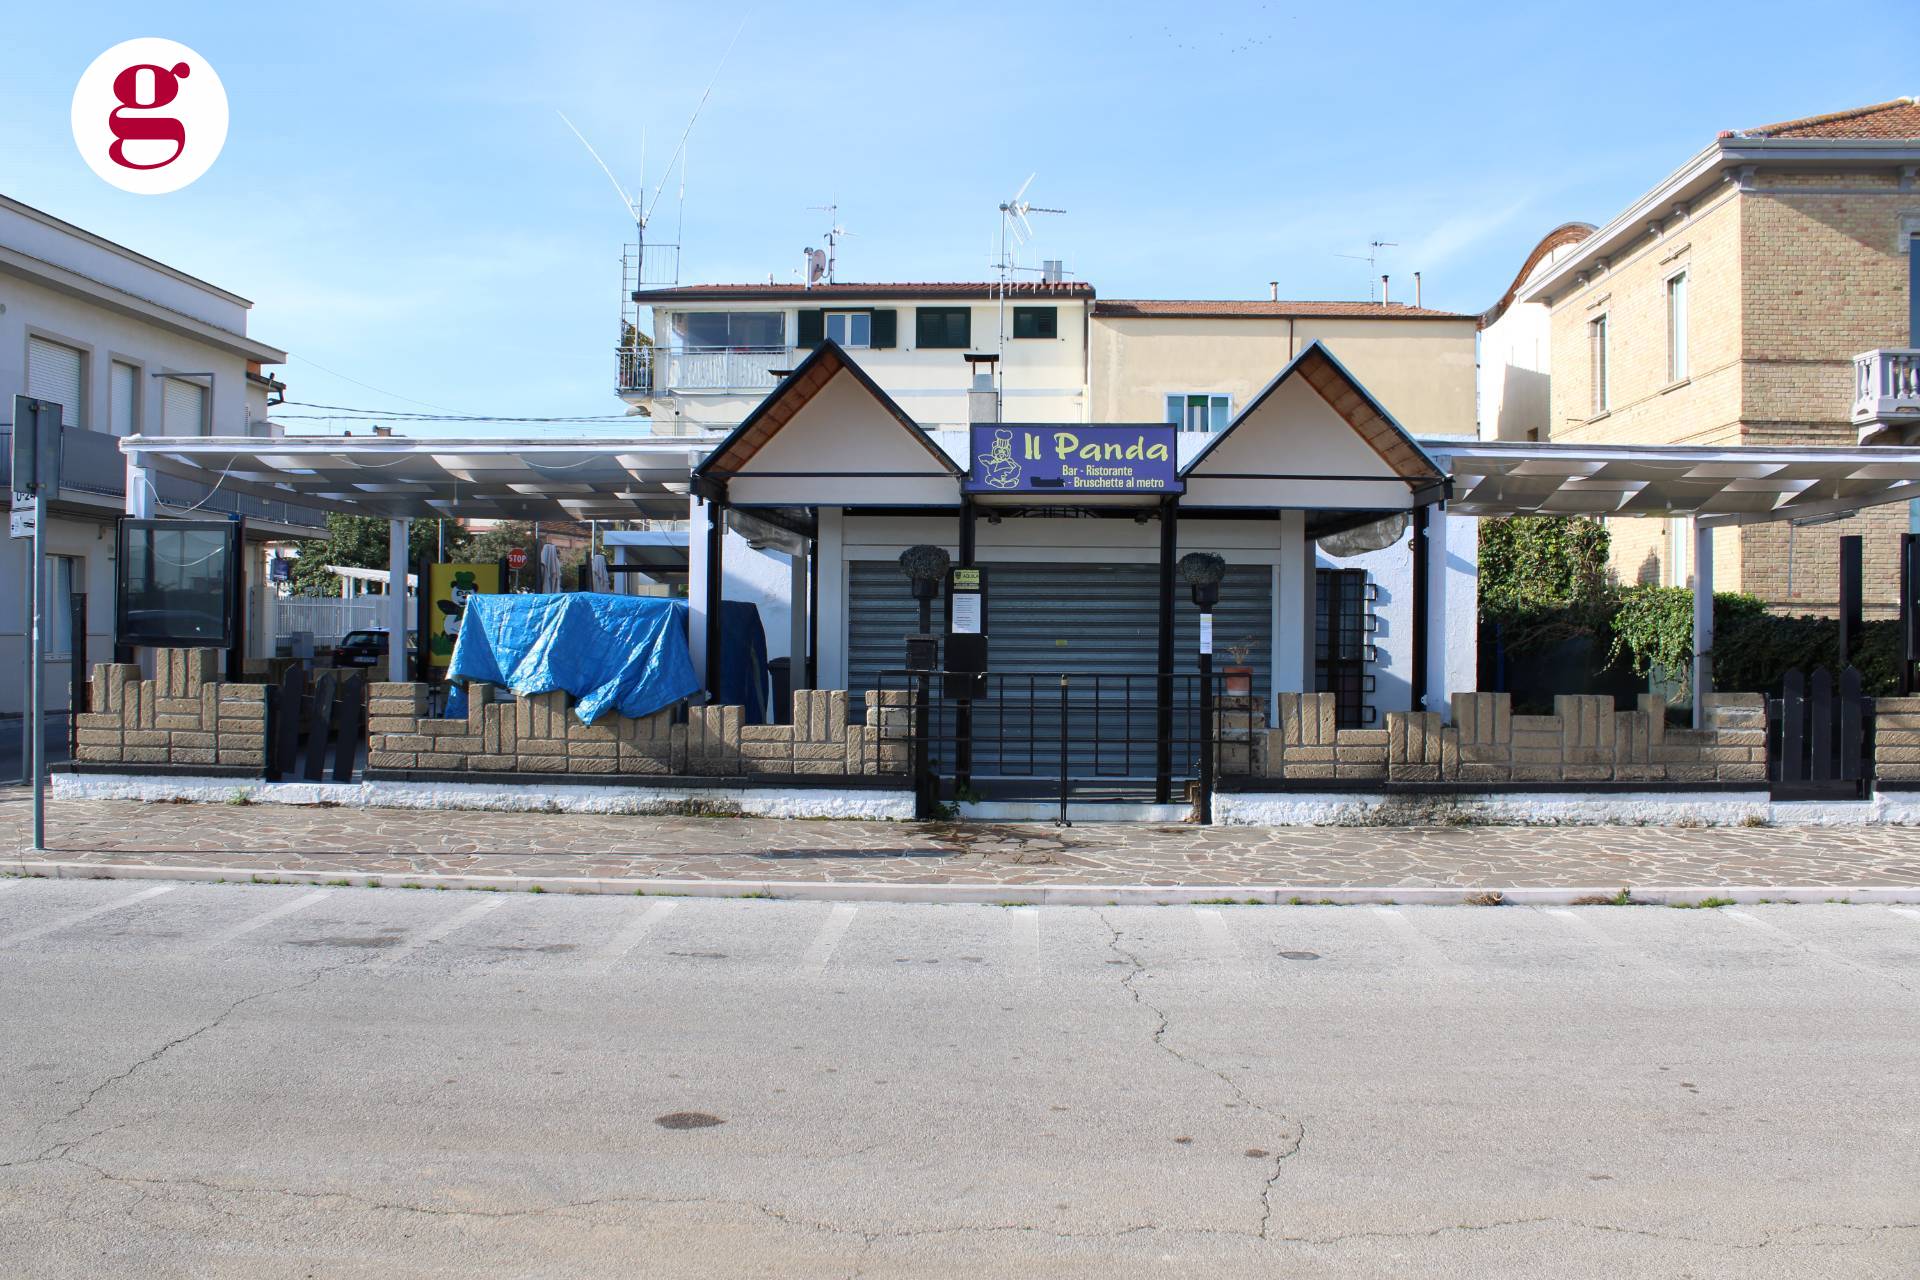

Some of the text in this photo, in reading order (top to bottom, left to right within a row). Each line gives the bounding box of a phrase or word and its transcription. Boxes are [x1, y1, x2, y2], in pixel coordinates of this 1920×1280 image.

[1025, 432, 1169, 462] Il Panda
[1062, 465, 1078, 476] Bar
[1086, 465, 1133, 476] Ristorante
[1074, 477, 1123, 488] Bruschette
[1126, 477, 1134, 488] al
[1137, 479, 1164, 488] metro
